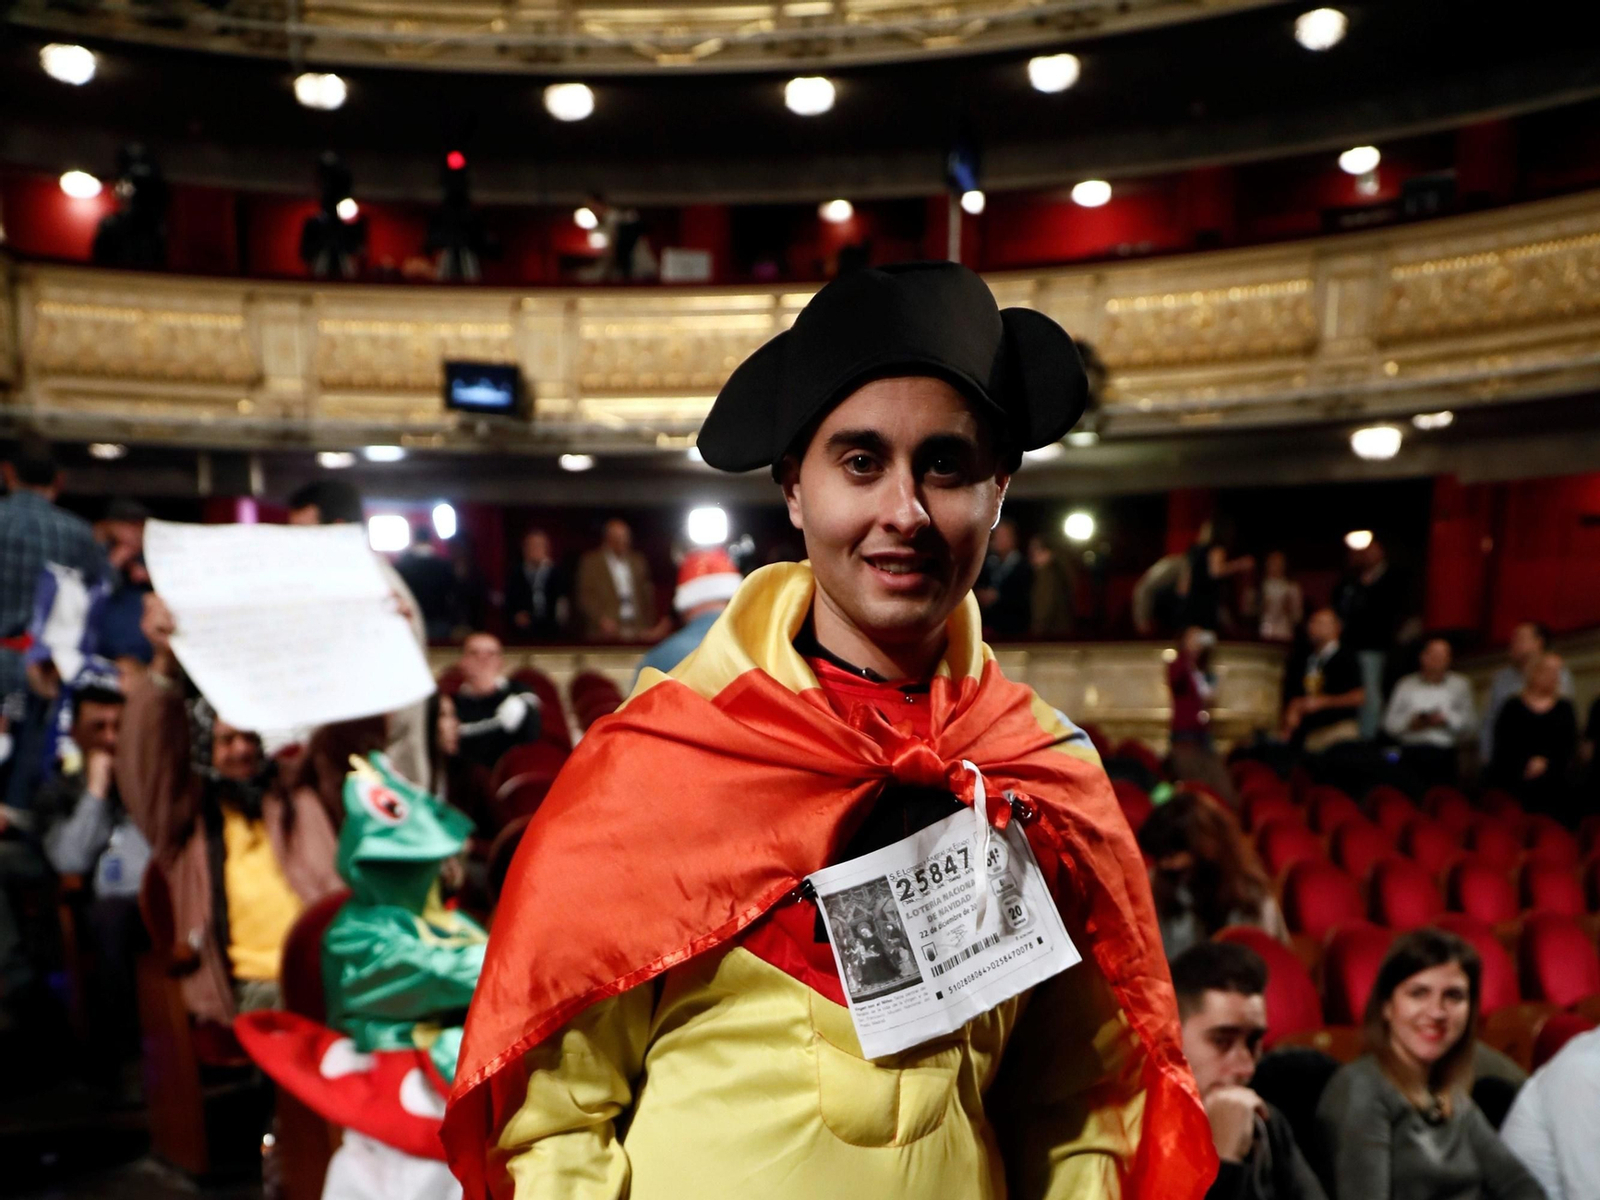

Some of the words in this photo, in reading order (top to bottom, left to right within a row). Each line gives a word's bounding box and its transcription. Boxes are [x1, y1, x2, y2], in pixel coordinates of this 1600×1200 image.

[896, 846, 968, 902] 25847
[906, 897, 942, 920] LOTERÍA
[942, 879, 976, 901] NACIONA
[927, 912, 938, 923] DE
[938, 894, 972, 917] NAVIDAD
[1008, 905, 1023, 920] 20
[919, 930, 929, 939] 22
[930, 926, 938, 935] de
[938, 912, 962, 930] diciembre
[962, 907, 970, 916] de
